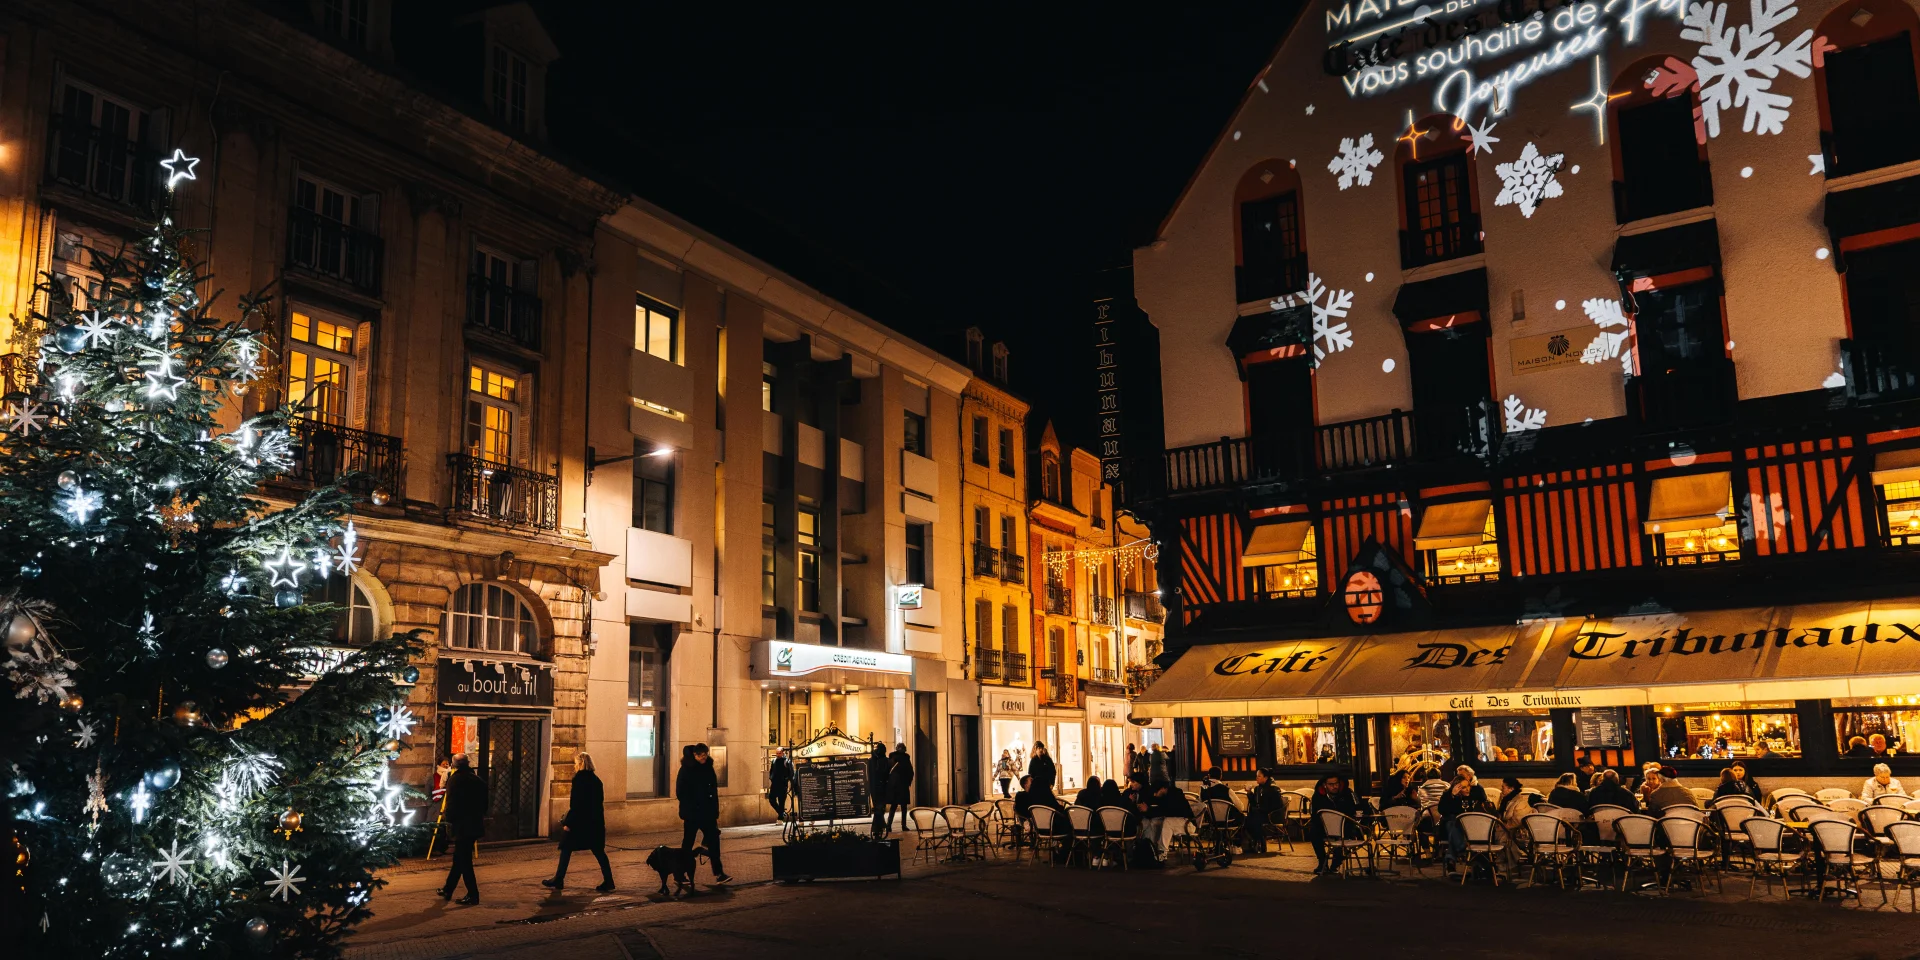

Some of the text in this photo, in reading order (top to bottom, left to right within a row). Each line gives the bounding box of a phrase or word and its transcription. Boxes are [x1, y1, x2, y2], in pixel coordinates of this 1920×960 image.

[1343, 61, 1408, 95] Vous
[1416, 20, 1543, 75] souhaite
[1553, 3, 1597, 32] de
[1438, 26, 1607, 131] Joyeuses
[1518, 355, 1555, 366] MAISON
[1213, 623, 1920, 677] Café Des Tribunaux
[458, 671, 537, 696] au bout du fil
[1450, 694, 1581, 709] Café Des Tribunaux
